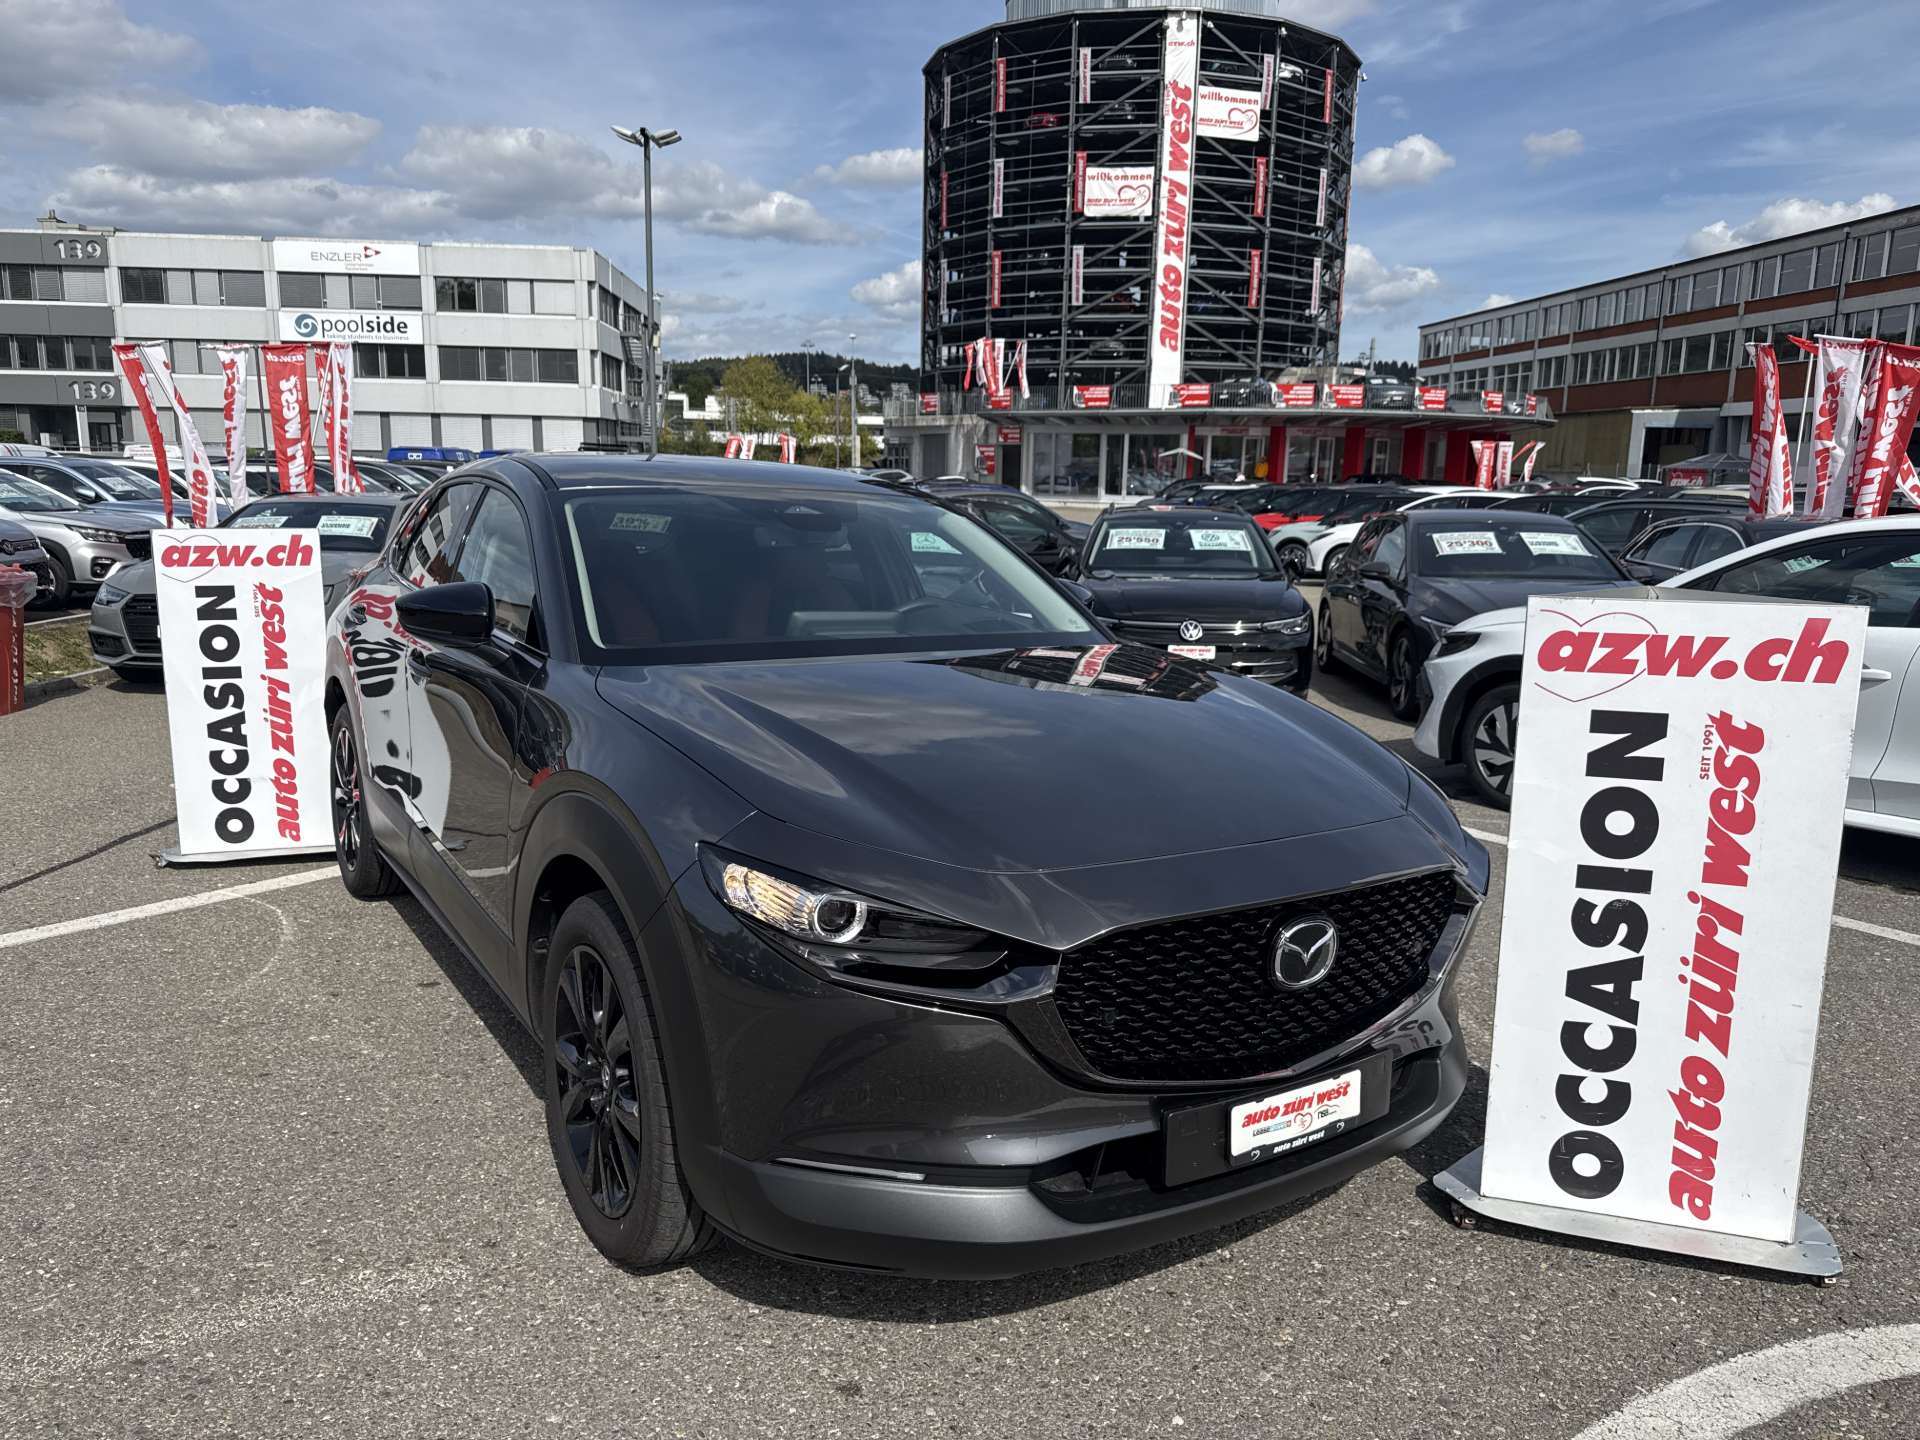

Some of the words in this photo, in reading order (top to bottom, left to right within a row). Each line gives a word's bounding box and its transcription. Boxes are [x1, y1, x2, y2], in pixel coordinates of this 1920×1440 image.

[1168, 79, 1192, 171] west
[1200, 91, 1259, 105] willkommen
[1087, 171, 1152, 181] willkommen
[54, 239, 102, 260] 139
[1160, 175, 1188, 263] züri
[310, 251, 362, 262] ENZLER
[321, 315, 408, 338] poolside
[1158, 263, 1183, 353] auto
[69, 380, 116, 400] 139
[161, 535, 313, 568] azw.ch
[253, 581, 289, 670] west
[1537, 618, 1850, 685] azw.ch
[194, 585, 255, 844] OCCASION
[260, 673, 296, 757] züri
[1703, 724, 1714, 751] 1991
[269, 757, 301, 842] auto
[1699, 755, 1711, 780] SEIT
[1701, 710, 1765, 888] west
[1548, 709, 1669, 1200] OCCASION
[1678, 890, 1744, 1059] züri
[1241, 1106, 1279, 1129] auto
[1281, 1091, 1315, 1118] züri
[1316, 1081, 1351, 1106] west
[1666, 1054, 1726, 1222] auto
[1273, 1141, 1291, 1154] auto
[1291, 1135, 1308, 1149] züri
[1308, 1129, 1325, 1142] west
